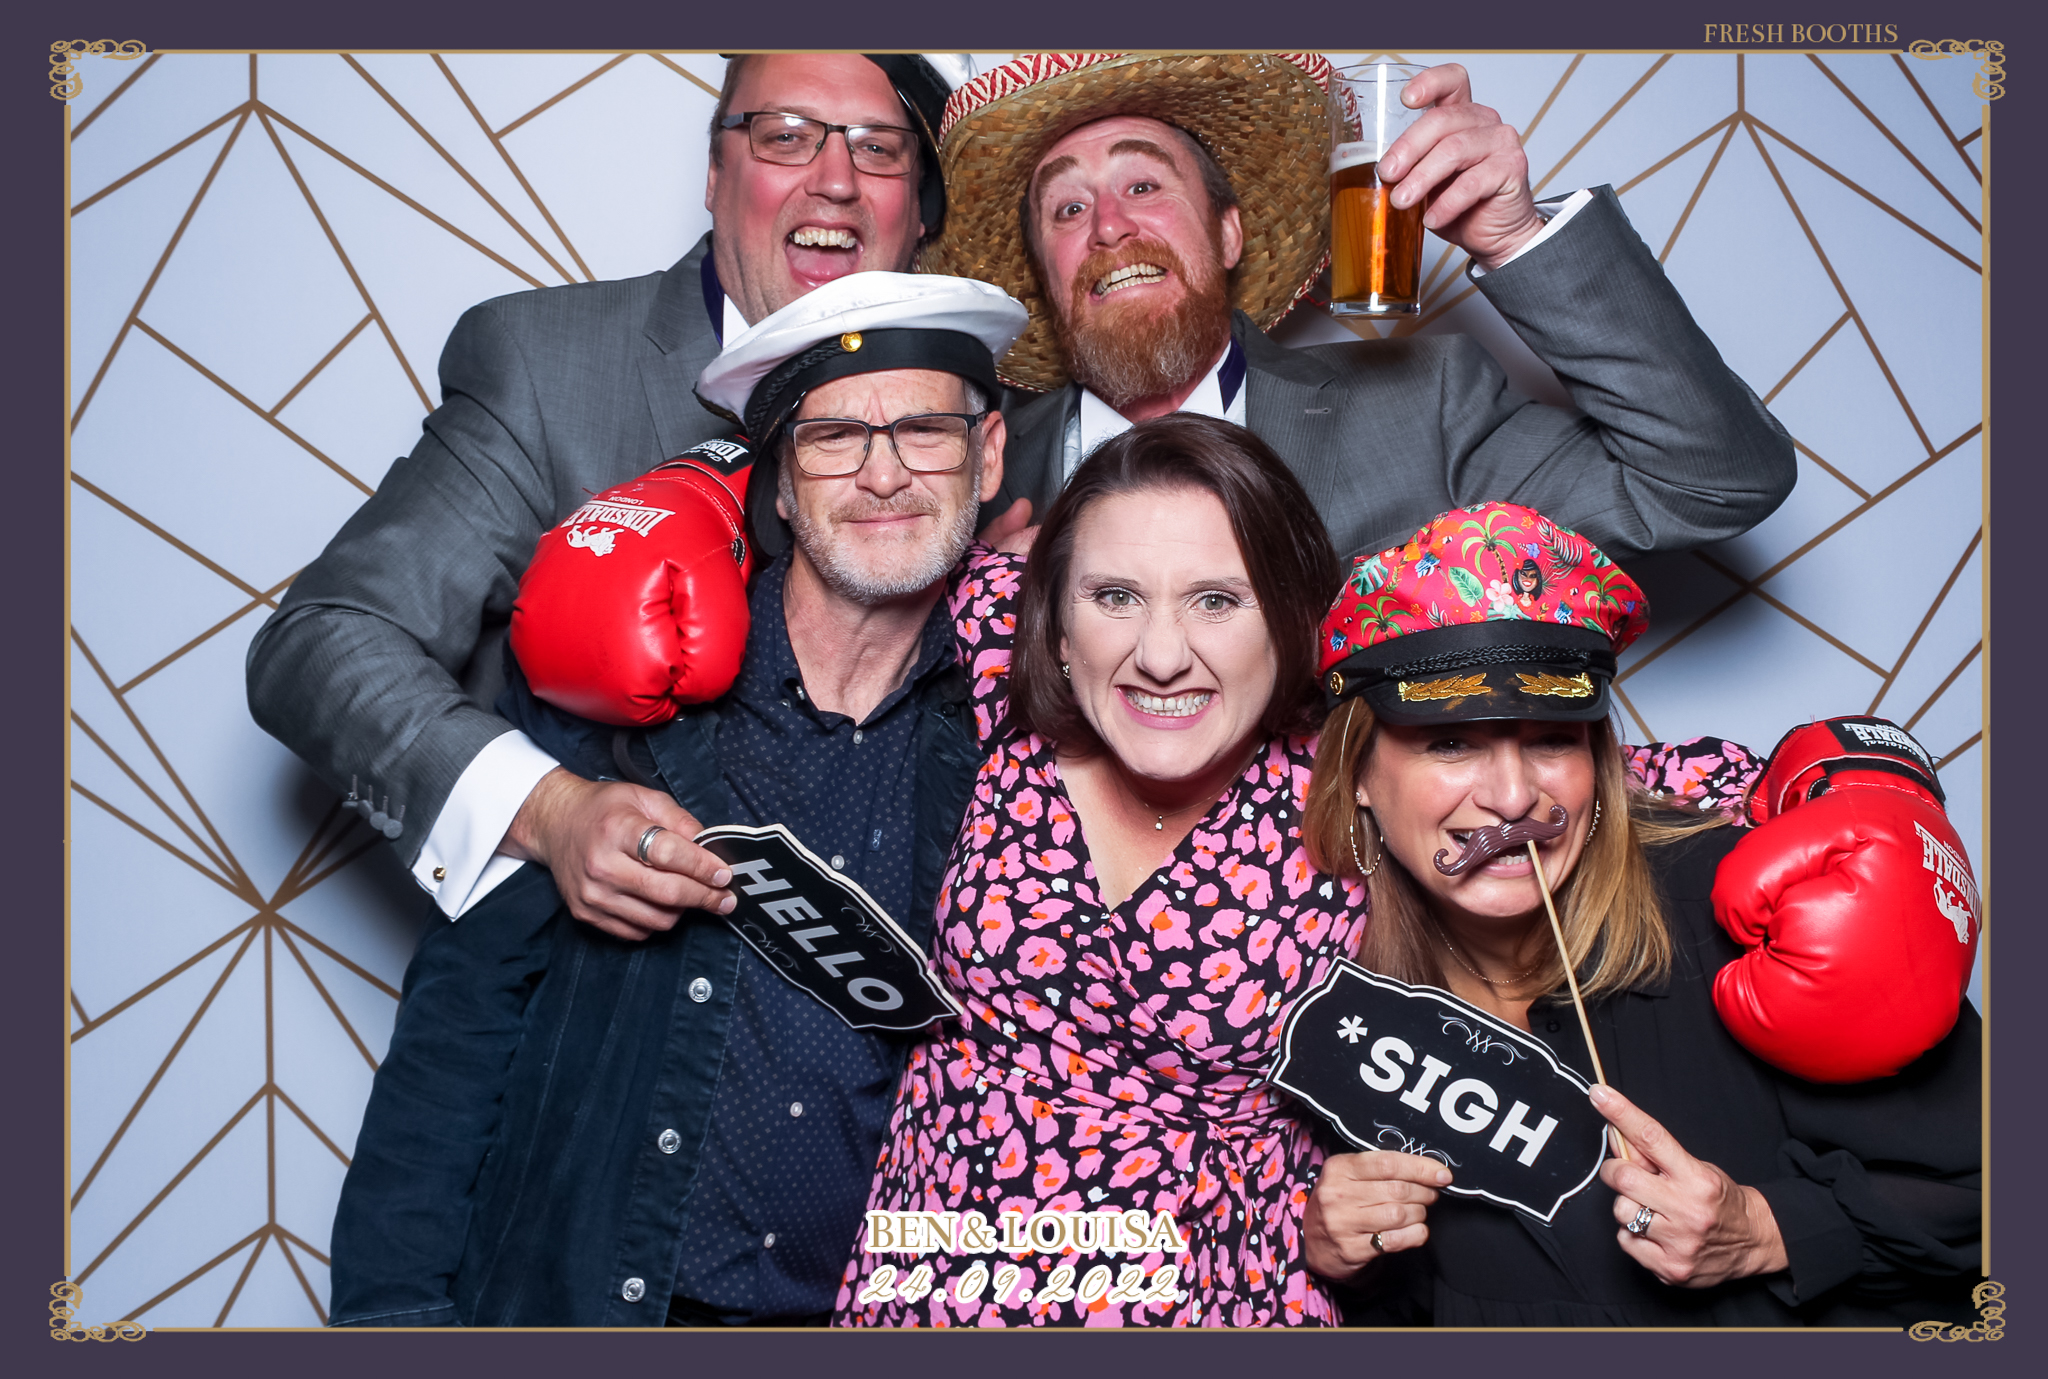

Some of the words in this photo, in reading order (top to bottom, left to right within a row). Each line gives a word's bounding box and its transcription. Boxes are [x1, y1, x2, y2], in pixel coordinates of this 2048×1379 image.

[691, 441, 749, 463] LONS
[608, 496, 645, 505] LONDON
[1943, 840, 1970, 873] LONDON
[731, 858, 904, 1011] HELLO
